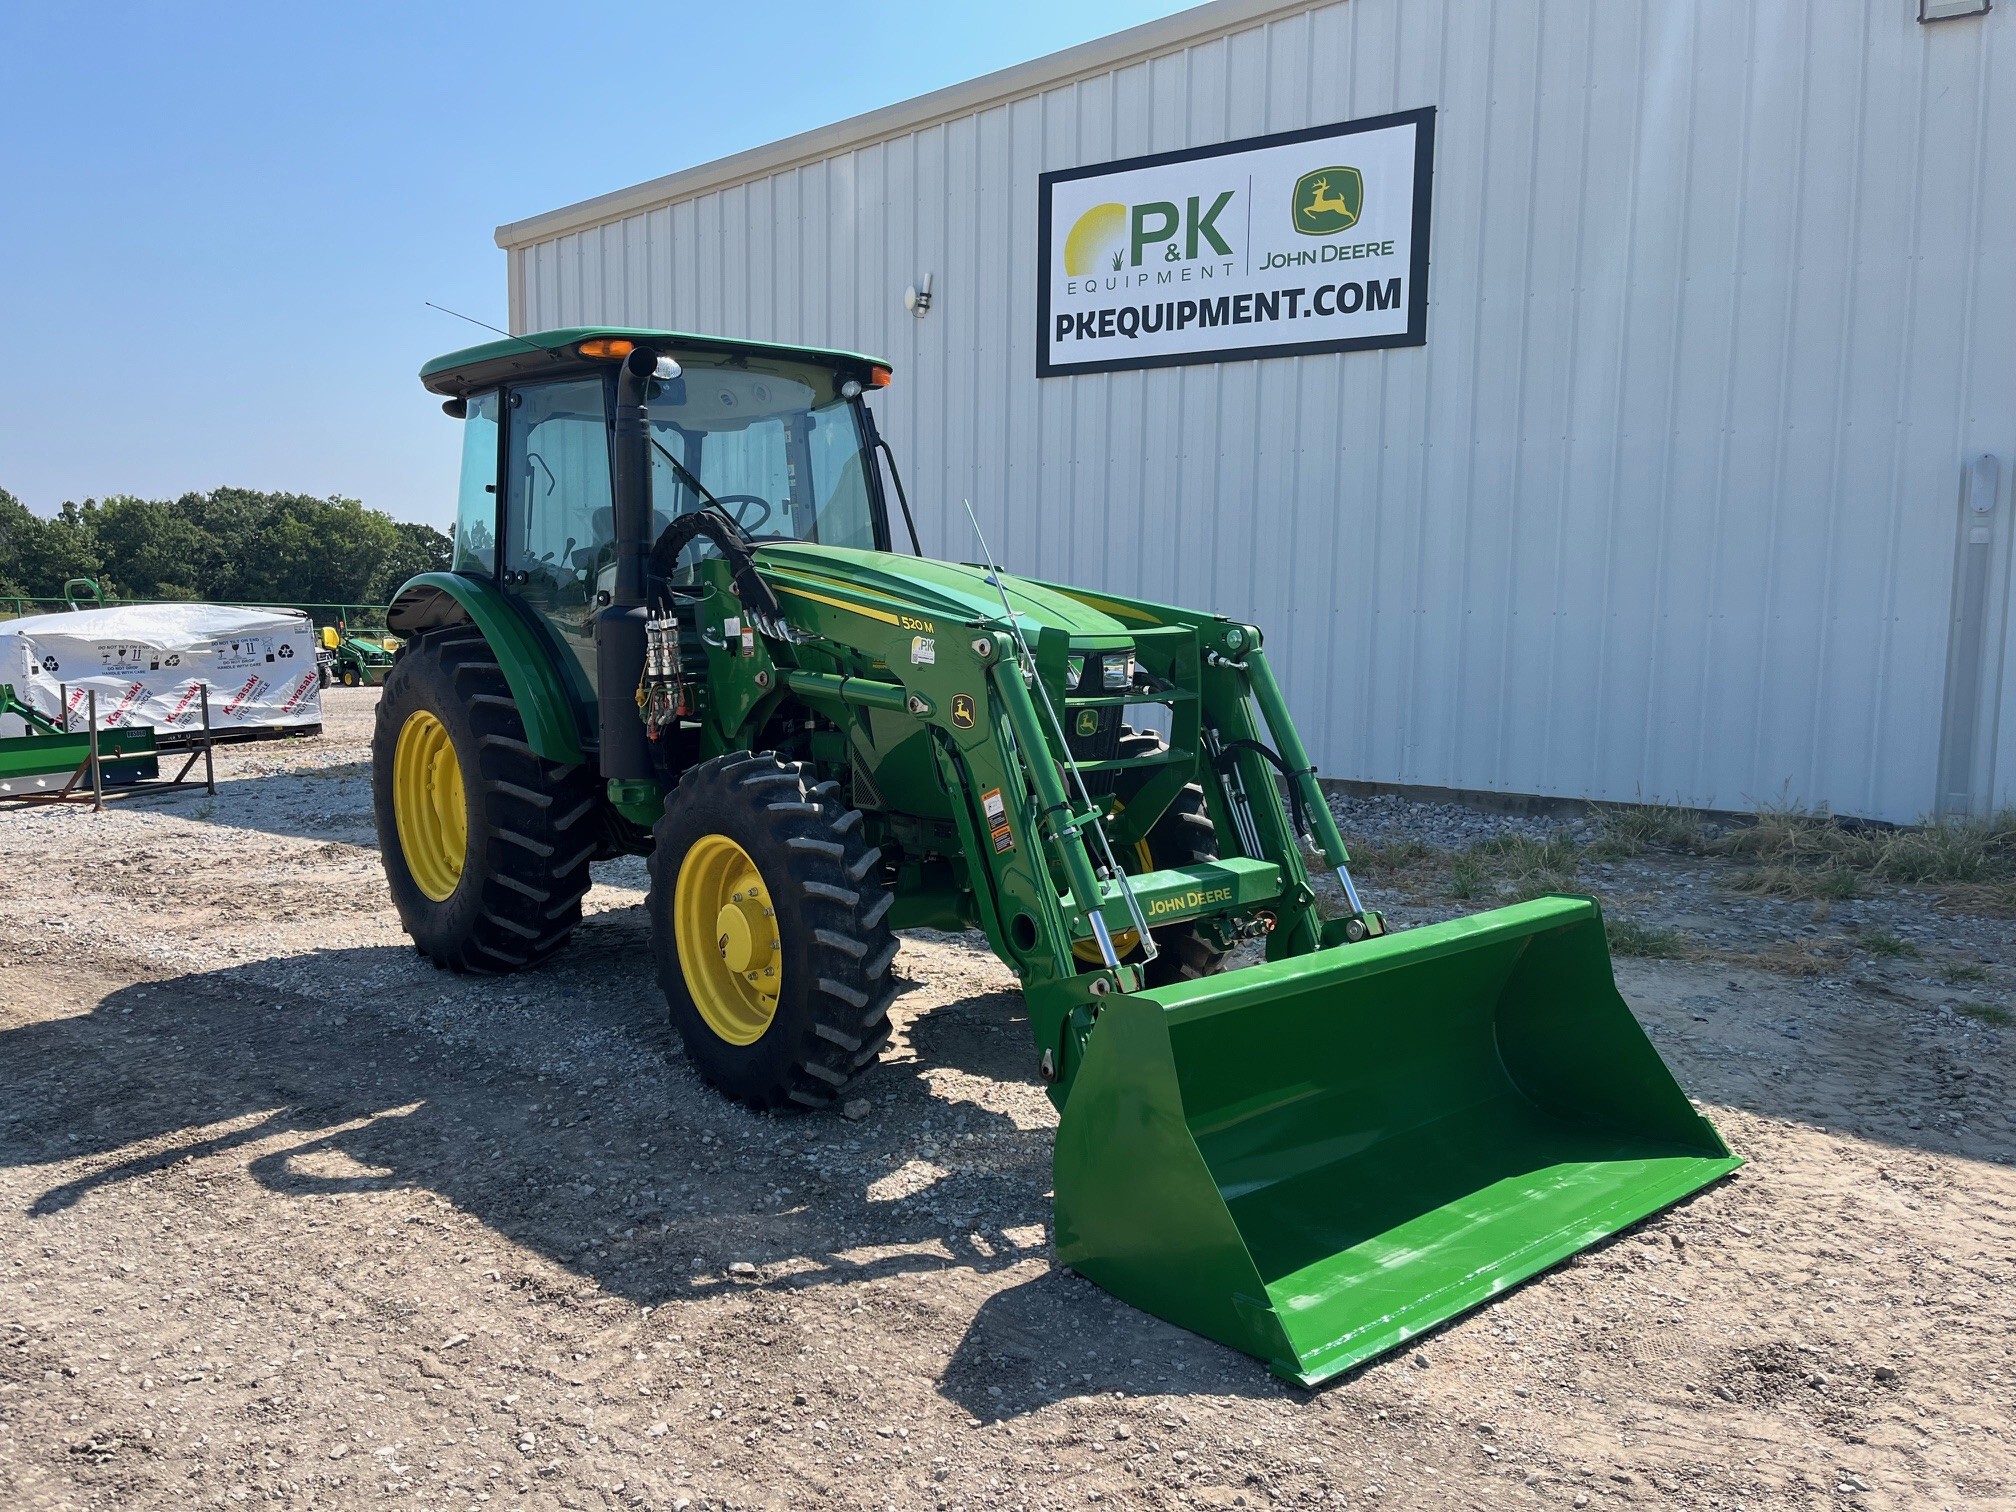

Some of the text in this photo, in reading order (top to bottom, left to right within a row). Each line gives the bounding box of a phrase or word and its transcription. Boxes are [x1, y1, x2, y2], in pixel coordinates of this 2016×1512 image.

[1258, 240, 1395, 271] JOHN DEERE
[1067, 262, 1234, 295] EQUIPMENT
[1055, 277, 1402, 343] PKEQUIPMENT.COM
[901, 616, 935, 634] 520 M
[165, 680, 202, 724] Kawasaki
[222, 673, 260, 716] Kawasaki
[281, 670, 318, 713] Kawasaki
[1148, 887, 1233, 916] JOHN DEERE
